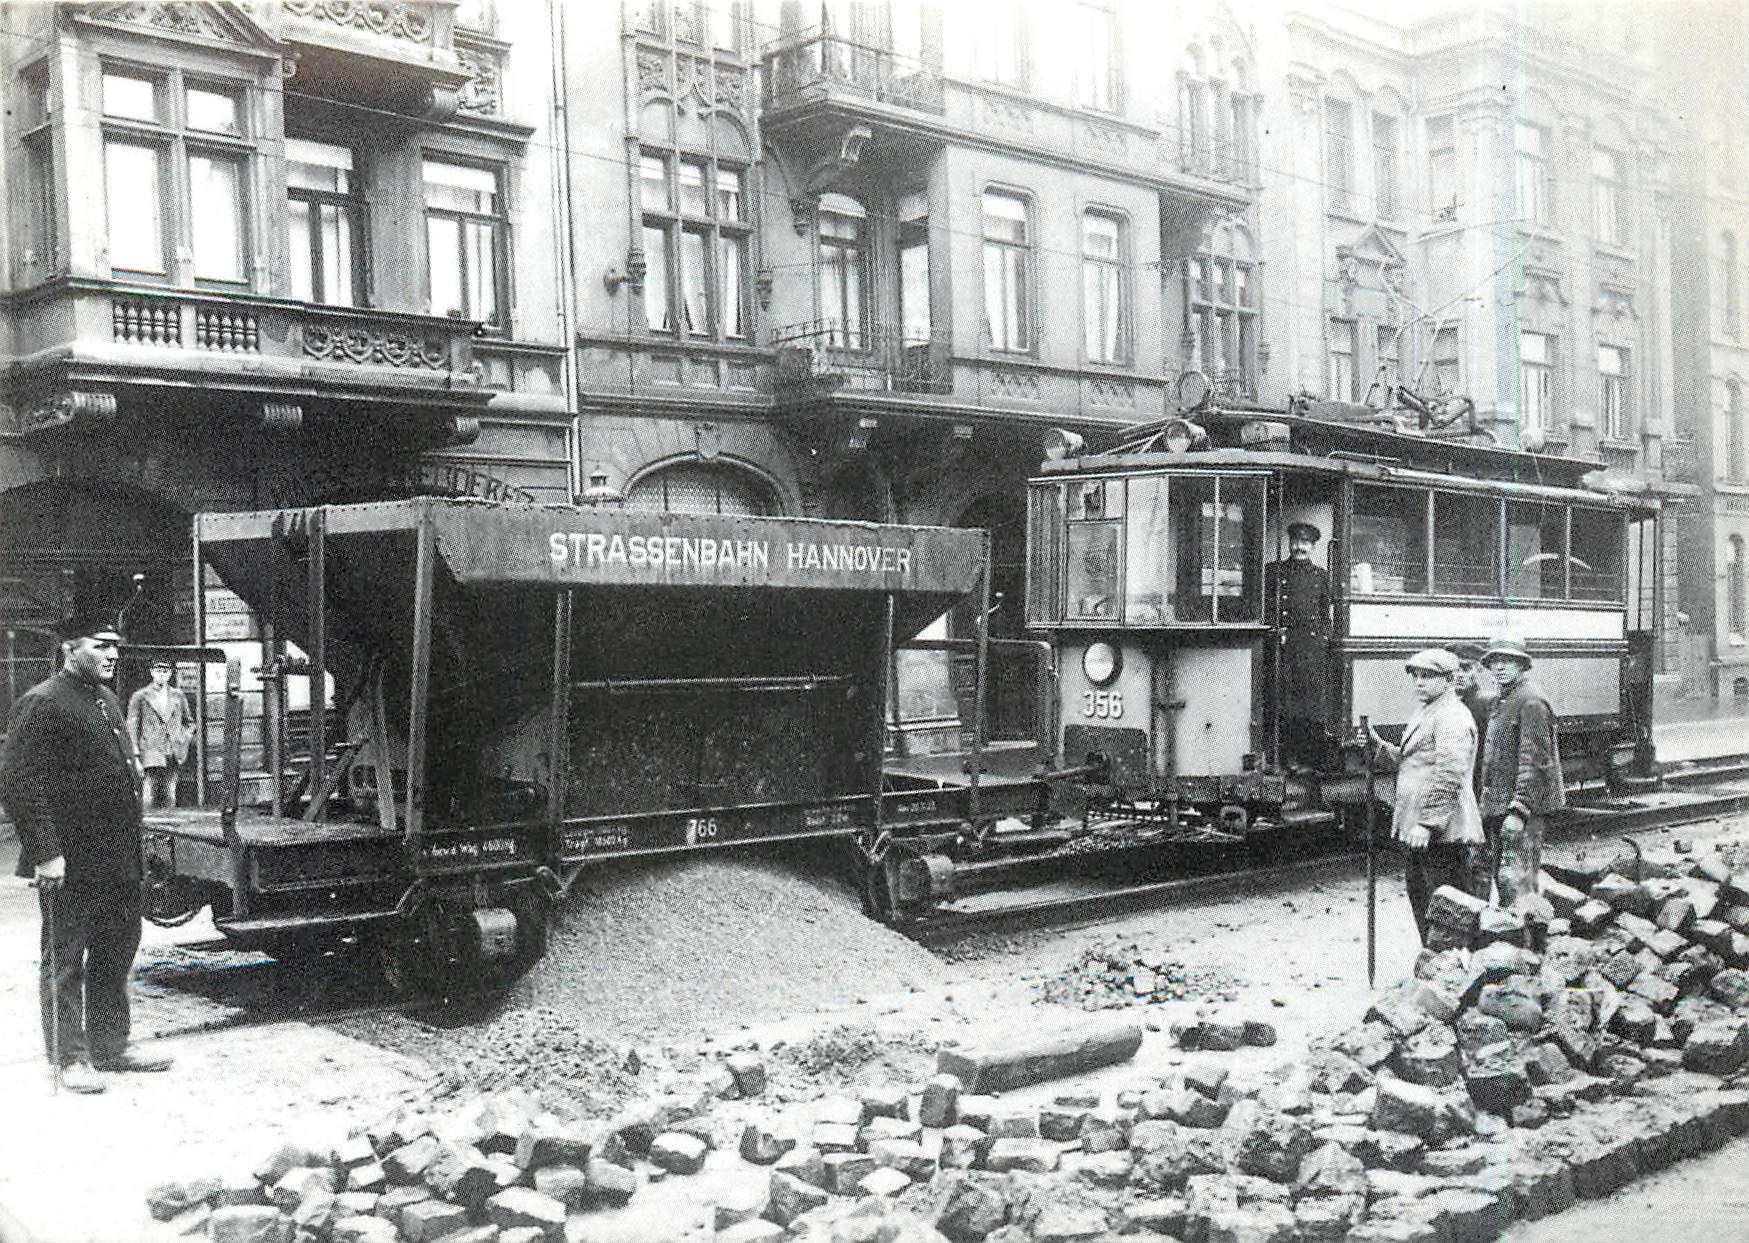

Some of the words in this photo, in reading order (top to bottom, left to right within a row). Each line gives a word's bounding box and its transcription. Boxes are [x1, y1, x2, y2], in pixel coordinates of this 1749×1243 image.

[549, 532, 769, 569] STRASSENBAHN
[786, 542, 912, 575] HANNOVER
[1082, 689, 1123, 719] 356
